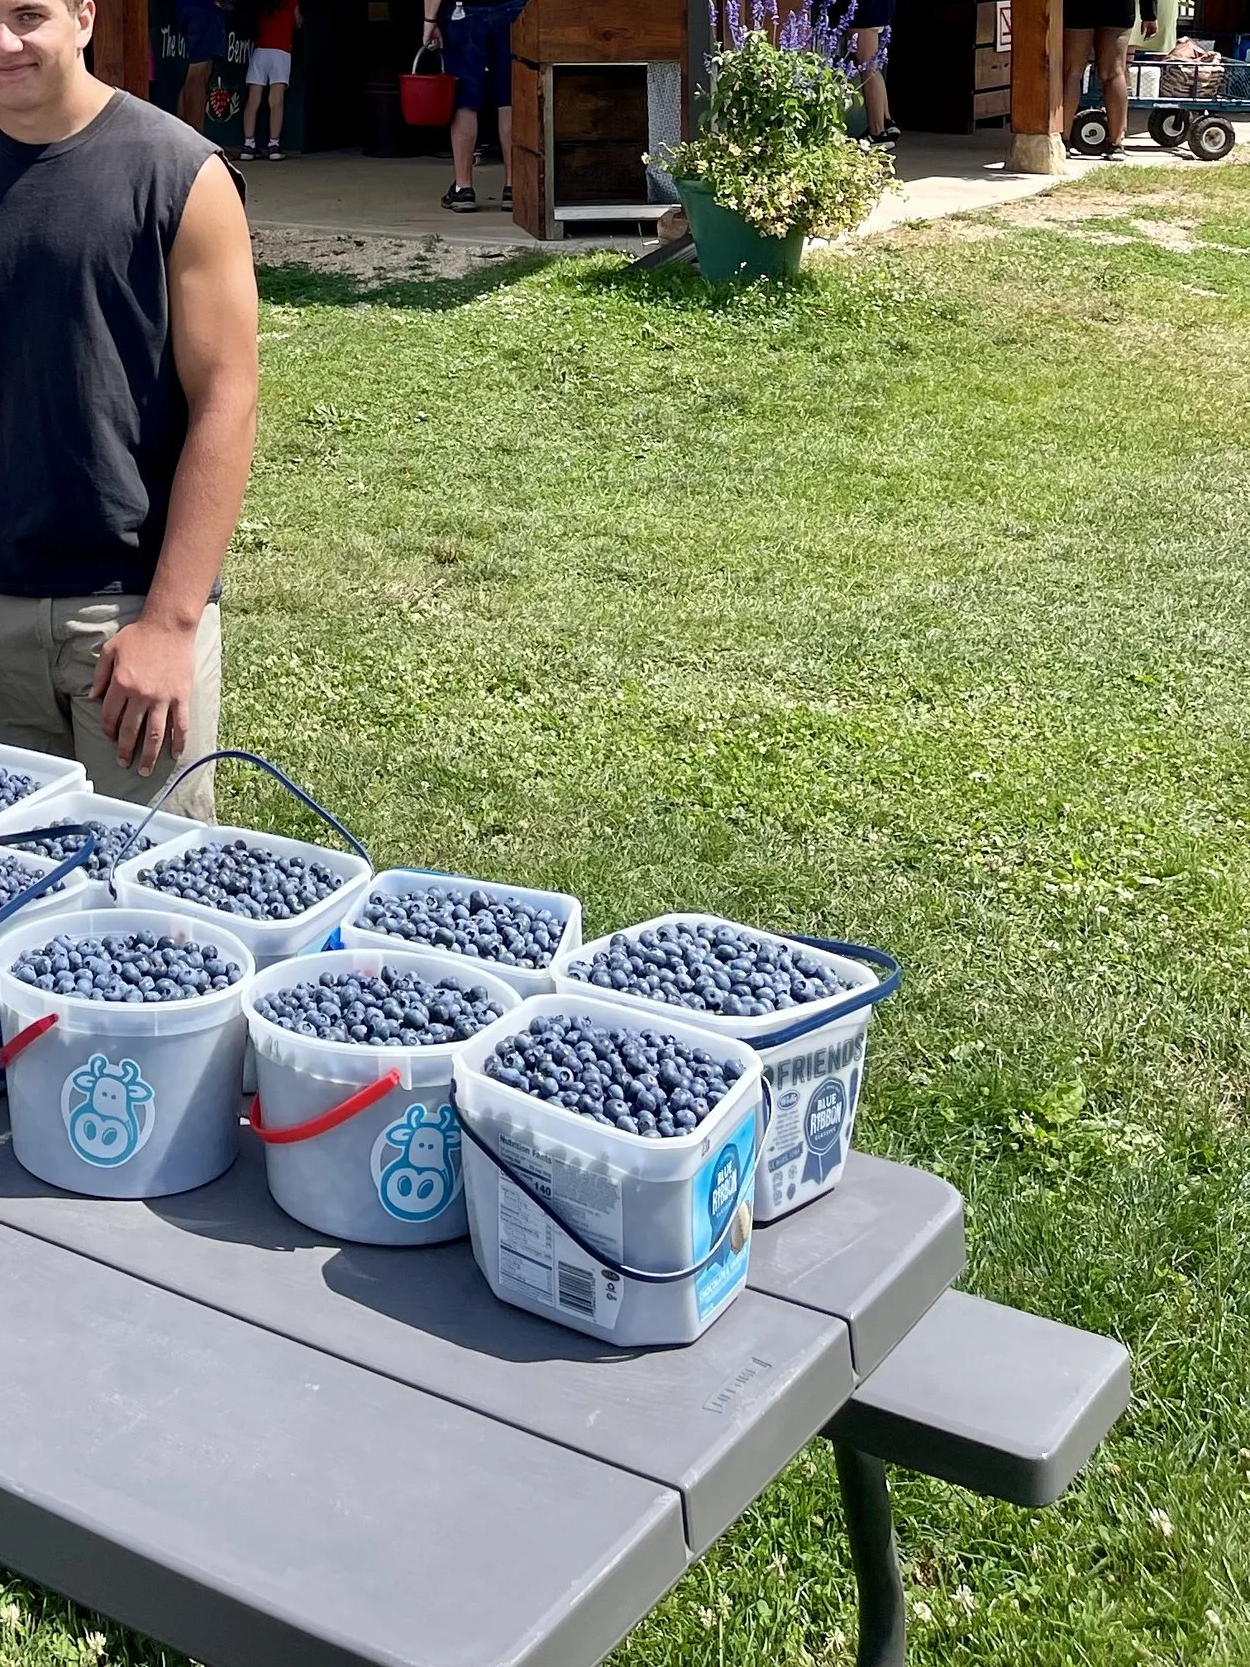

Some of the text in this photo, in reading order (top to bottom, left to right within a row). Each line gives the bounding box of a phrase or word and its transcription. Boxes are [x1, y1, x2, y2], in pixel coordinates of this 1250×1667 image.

[777, 1032, 864, 1091] FRIENDS
[817, 1093, 837, 1111] BLUE
[810, 1102, 842, 1136] RIBBON
[500, 1135, 530, 1155] Nutrition
[532, 1150, 552, 1164] Facts
[717, 1161, 733, 1185] BLUE
[535, 1182, 551, 1196] 140
[712, 1169, 738, 1215] RIBBON
